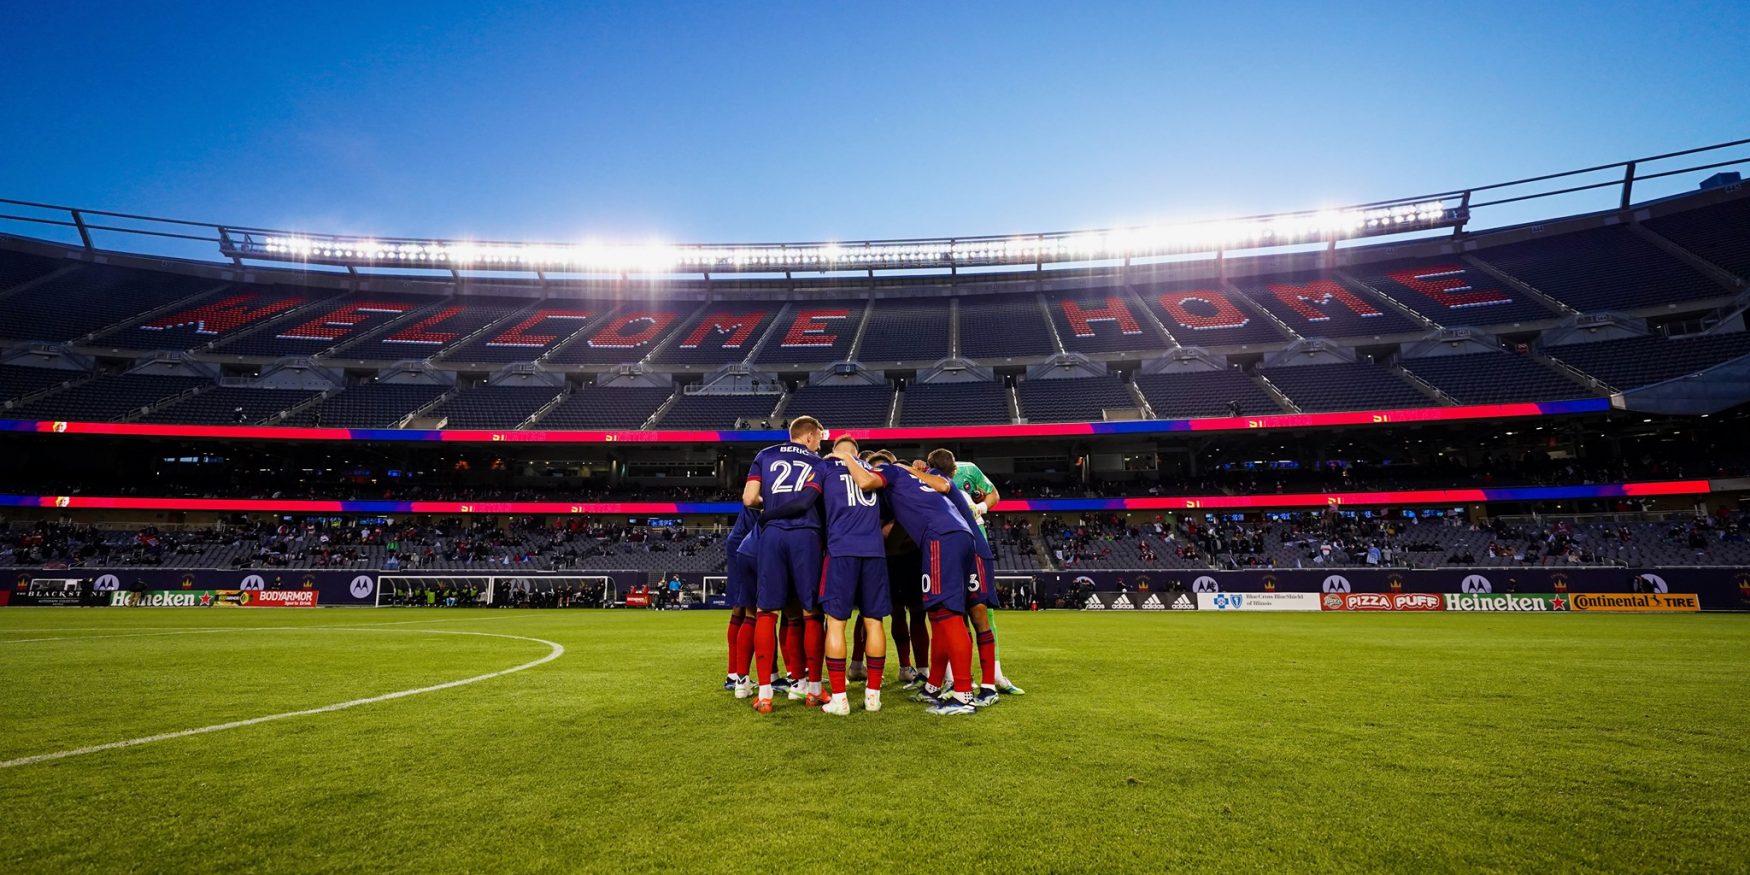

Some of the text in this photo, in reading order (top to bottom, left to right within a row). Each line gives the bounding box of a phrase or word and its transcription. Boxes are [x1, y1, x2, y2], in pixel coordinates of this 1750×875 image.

[139, 264, 1513, 349] WELCOME HOME
[770, 460, 813, 494] 27
[840, 474, 877, 507] 10
[260, 591, 312, 601] BODYARMOR
[1347, 595, 1390, 608] PIZZA
[1395, 595, 1438, 608] PUFF
[1444, 593, 1547, 611] Heineken
[1573, 594, 1695, 610] Continental TIRE
